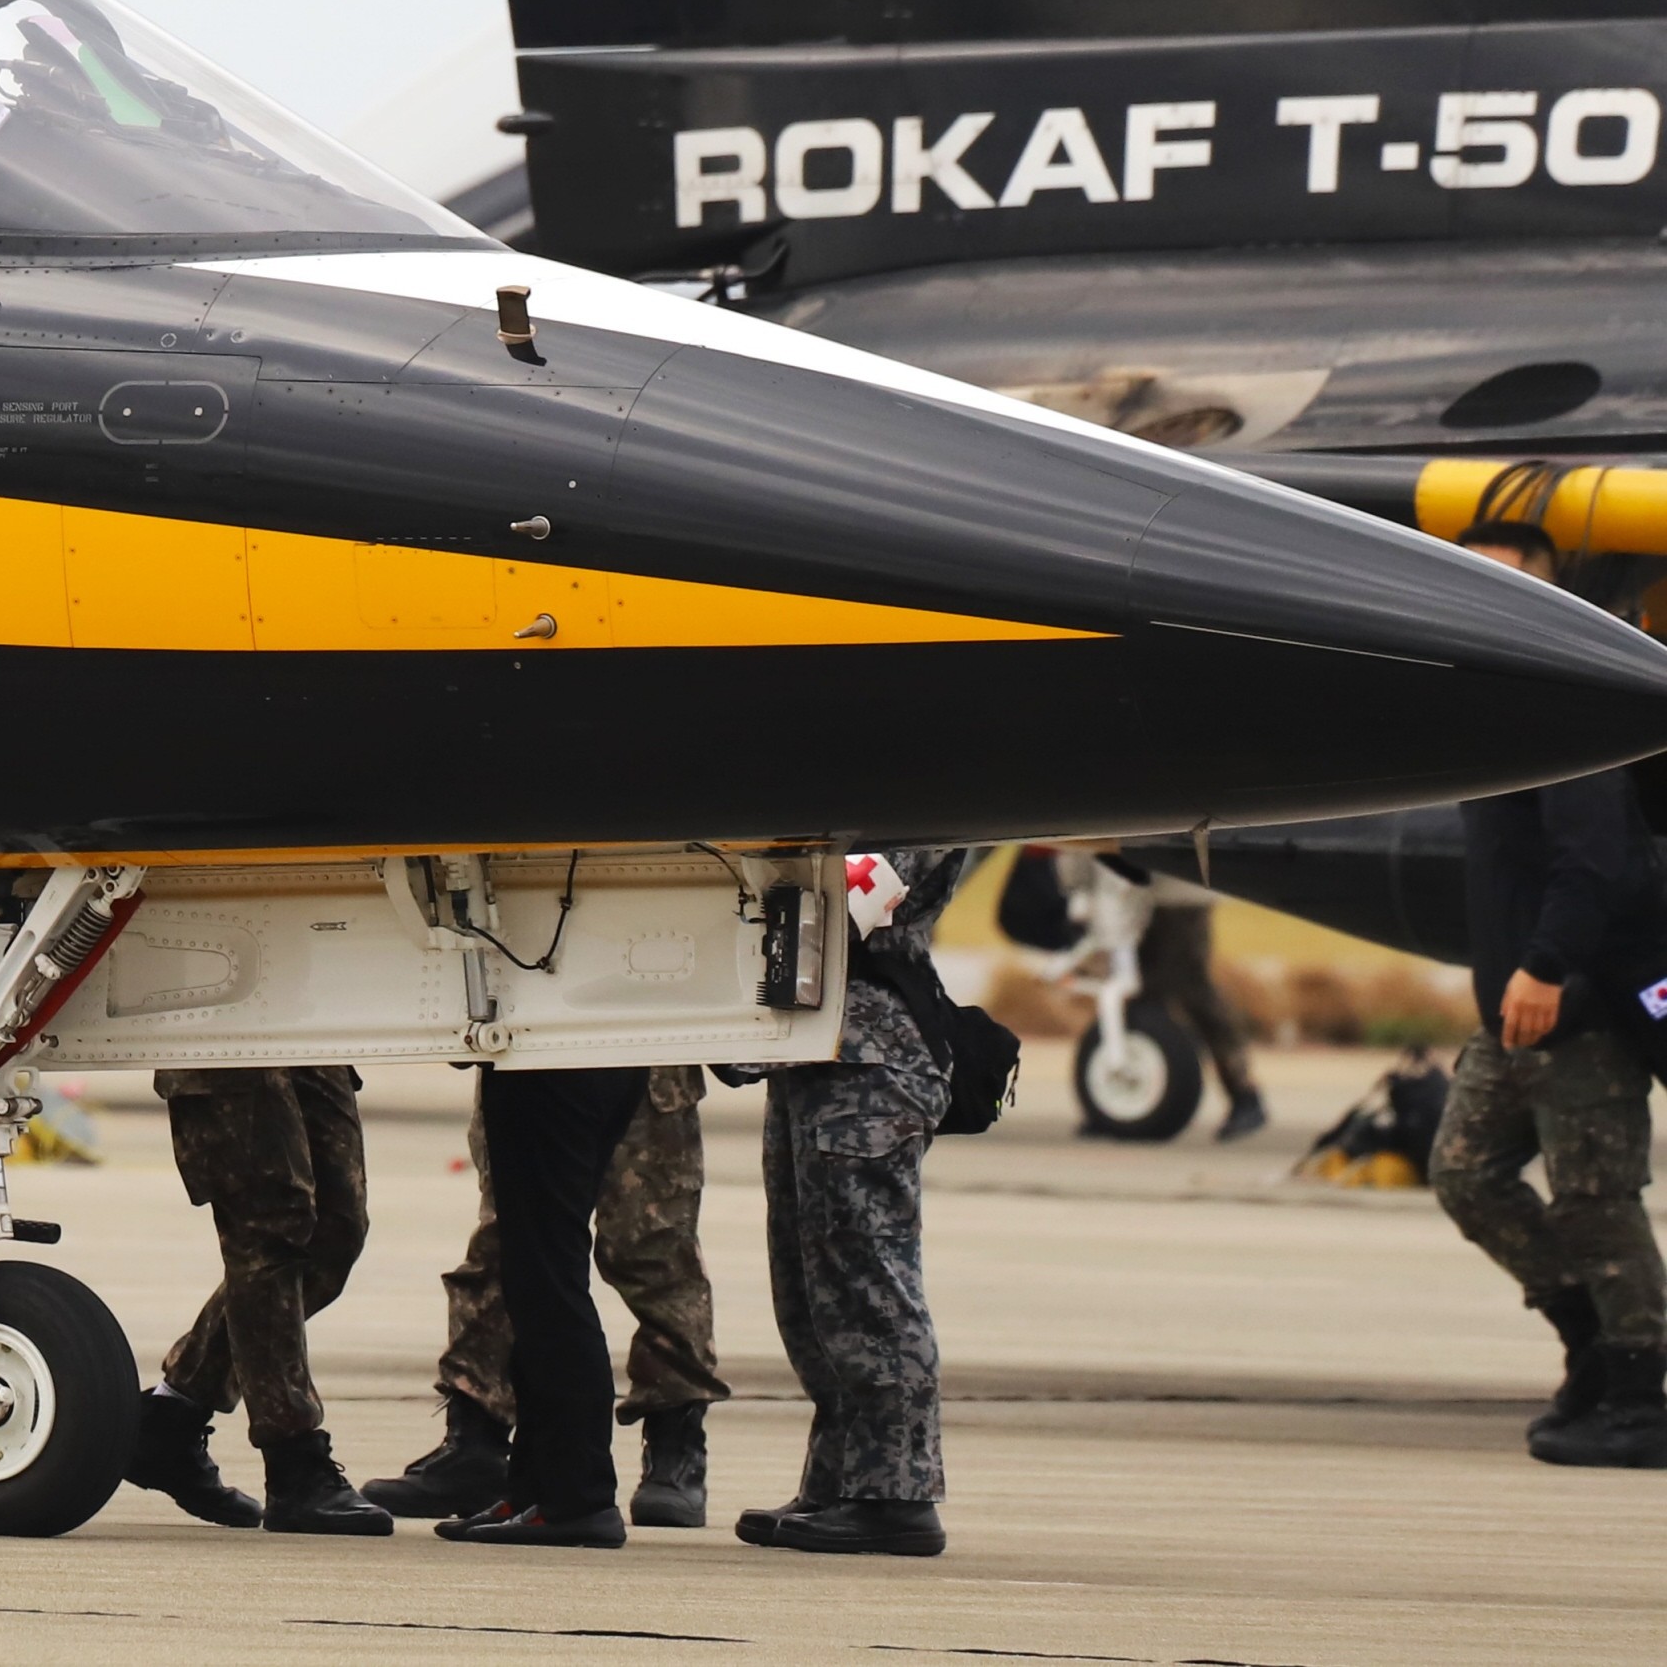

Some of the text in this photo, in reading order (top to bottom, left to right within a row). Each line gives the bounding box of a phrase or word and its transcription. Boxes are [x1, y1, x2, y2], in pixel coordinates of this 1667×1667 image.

[673, 86, 1660, 229] ROKAF T-50
[2, 402, 44, 412] SENSING
[51, 402, 78, 412] PORT
[33, 413, 93, 424] REGULATOR
